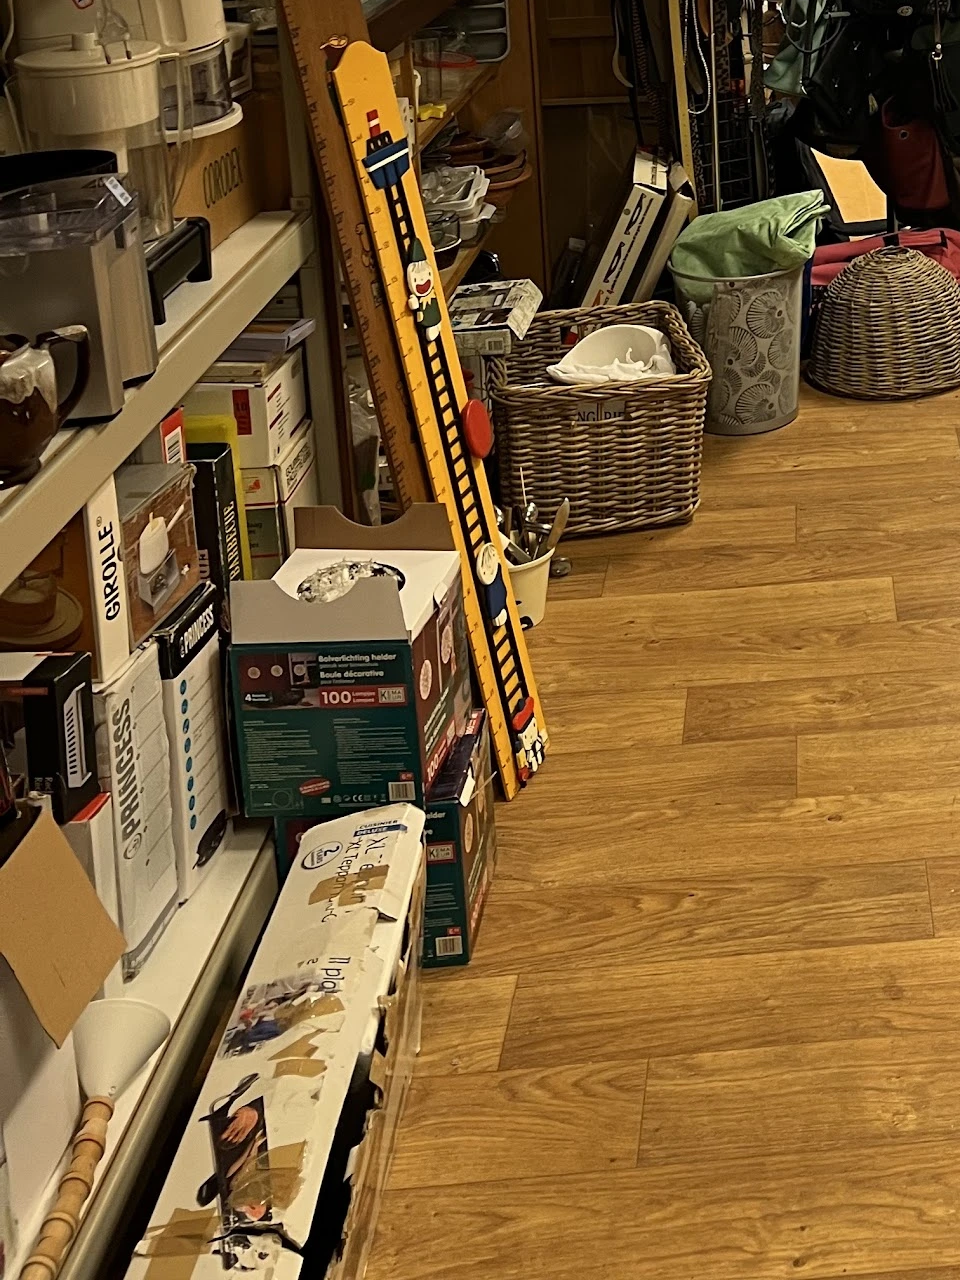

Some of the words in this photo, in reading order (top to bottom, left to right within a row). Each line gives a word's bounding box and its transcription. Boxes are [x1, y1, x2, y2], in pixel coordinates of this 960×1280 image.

[223, 500, 240, 581] BARBECUE
[98, 521, 120, 621] GIROLLE
[321, 691, 352, 704] 100
[113, 697, 141, 844] PRINCESS
[323, 845, 340, 857] 2
[356, 825, 388, 836] DELUXE
